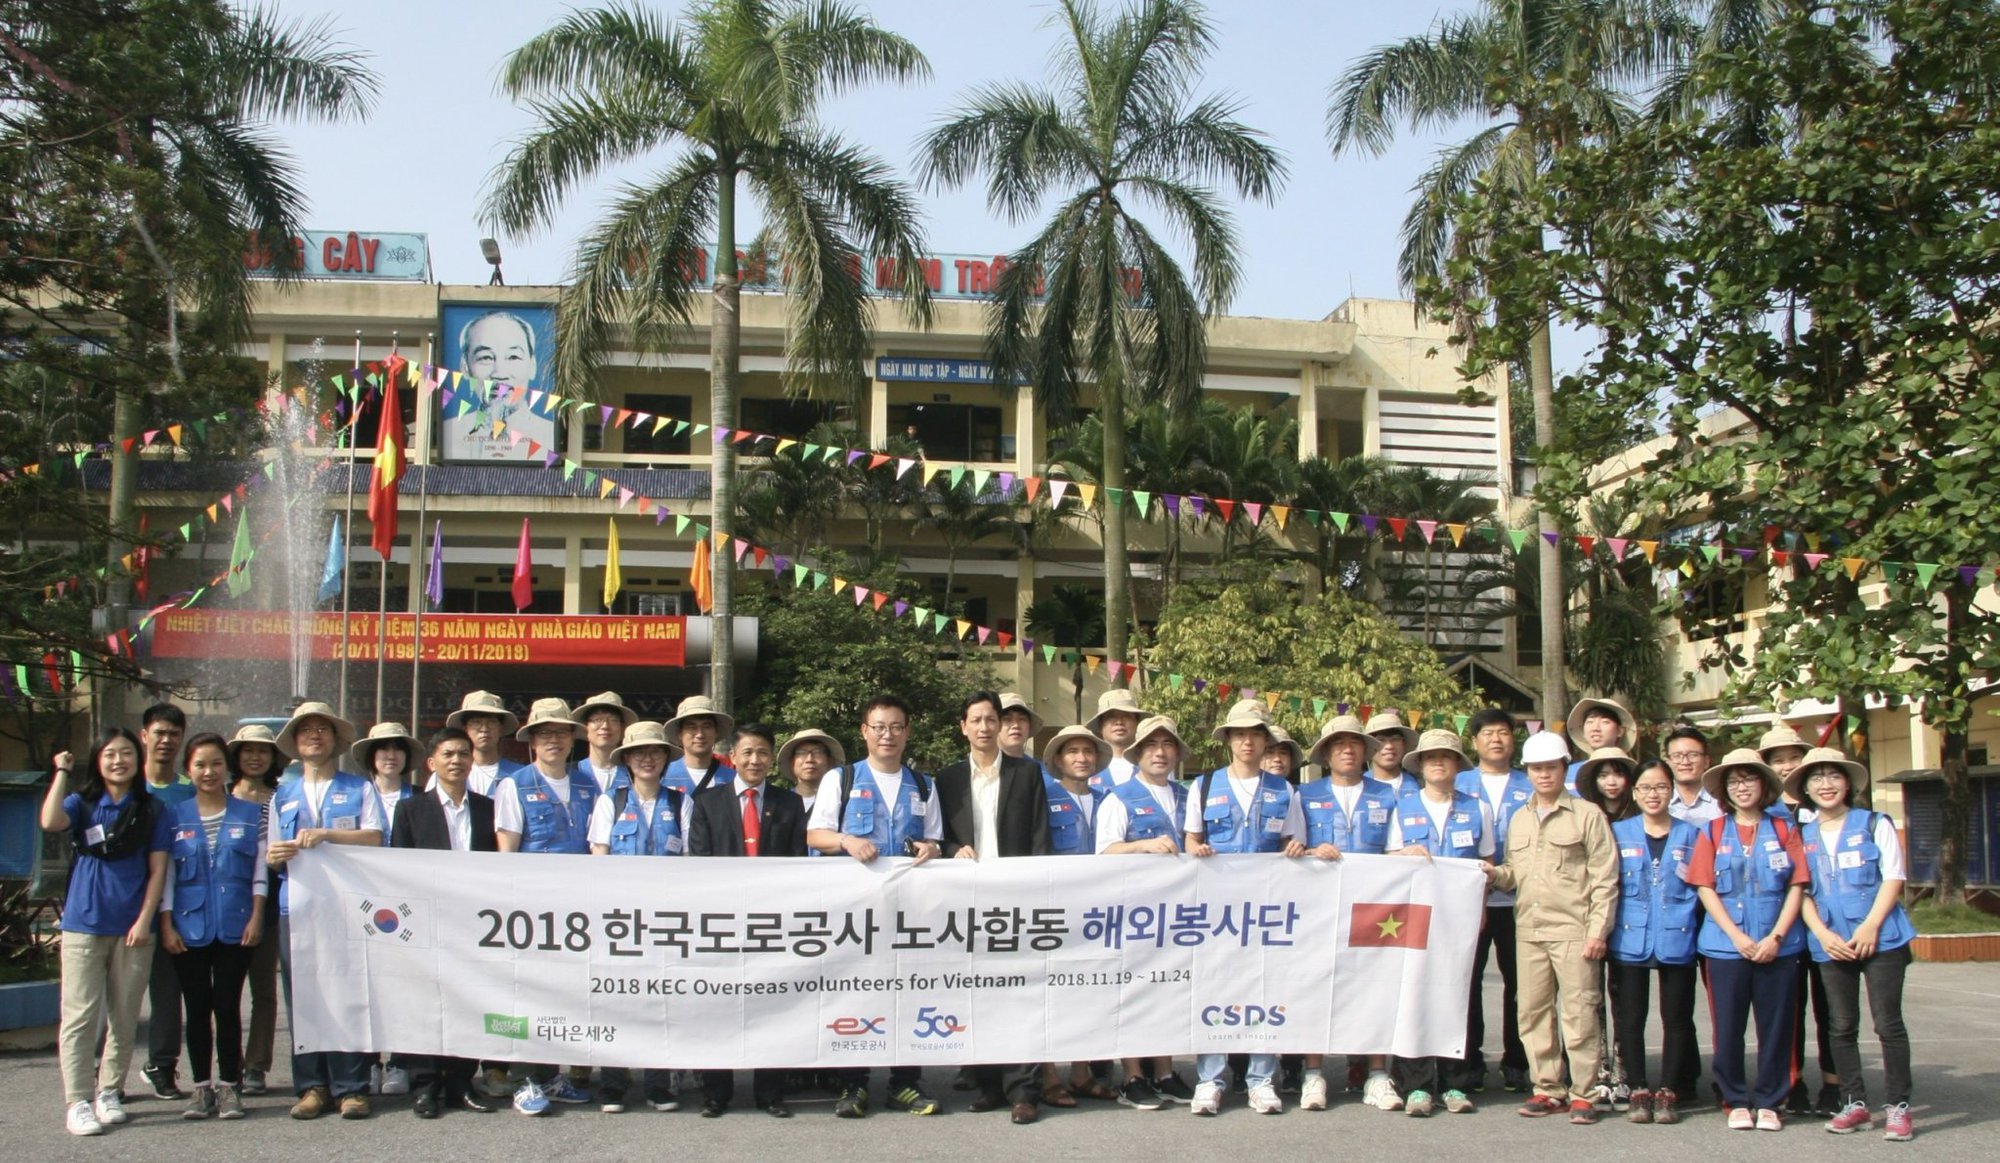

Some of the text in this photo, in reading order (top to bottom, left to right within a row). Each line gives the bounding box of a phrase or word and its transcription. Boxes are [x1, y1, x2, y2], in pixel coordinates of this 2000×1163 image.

[322, 231, 381, 273] CÂY
[166, 613, 210, 633] NHIỆT
[350, 614, 370, 637] KỶ
[420, 620, 439, 637] 36
[443, 618, 480, 638] NĂM
[484, 618, 527, 639] NGÀY
[531, 619, 564, 639] NHÀ
[566, 619, 602, 639] GIÁO
[607, 619, 638, 642] VIỆT
[643, 622, 680, 639] NAM
[437, 643, 529, 662] 20/11/2018)
[477, 901, 1301, 959] 2018 한국도로공사 노사합동 해외봉사단
[590, 977, 641, 995] 2018
[647, 978, 688, 996] KEC
[693, 978, 789, 996] Overseas
[793, 975, 904, 993] volunteers
[909, 973, 939, 990] for
[942, 973, 1026, 989] Vietnam
[1047, 971, 1132, 987] 2018.11.19
[1150, 969, 1191, 983] 11.24
[537, 1015, 567, 1024] 사단법인
[826, 1017, 886, 1036] ex
[1201, 1004, 1286, 1027] CSDS
[831, 1040, 887, 1052] 한국도로공사
